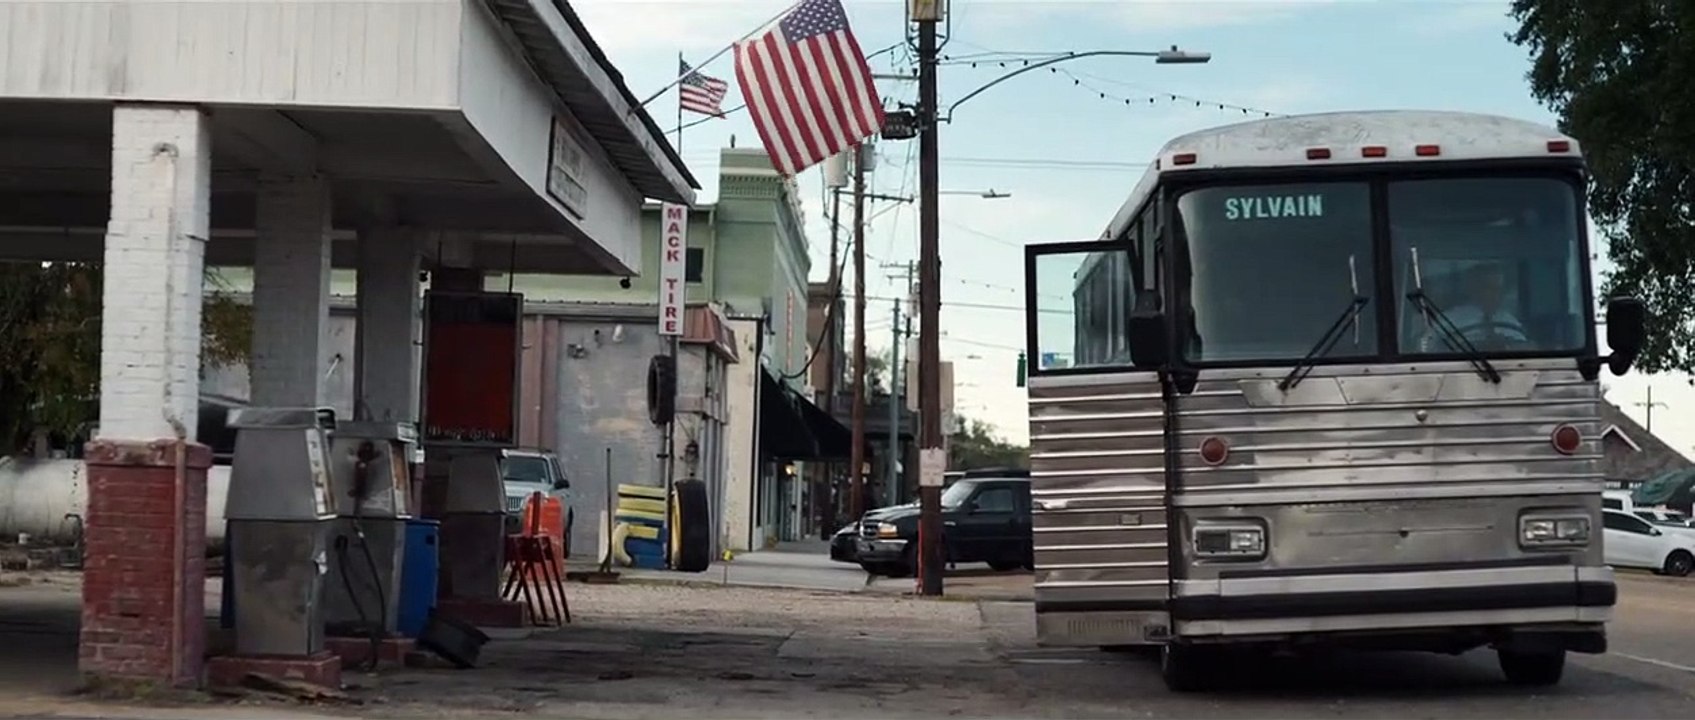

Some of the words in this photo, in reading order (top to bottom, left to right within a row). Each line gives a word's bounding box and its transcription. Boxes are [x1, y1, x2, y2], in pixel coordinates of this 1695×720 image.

[1225, 195, 1322, 219] SYLVAIN
[667, 208, 682, 262] MACK
[665, 278, 677, 333] TIRE
